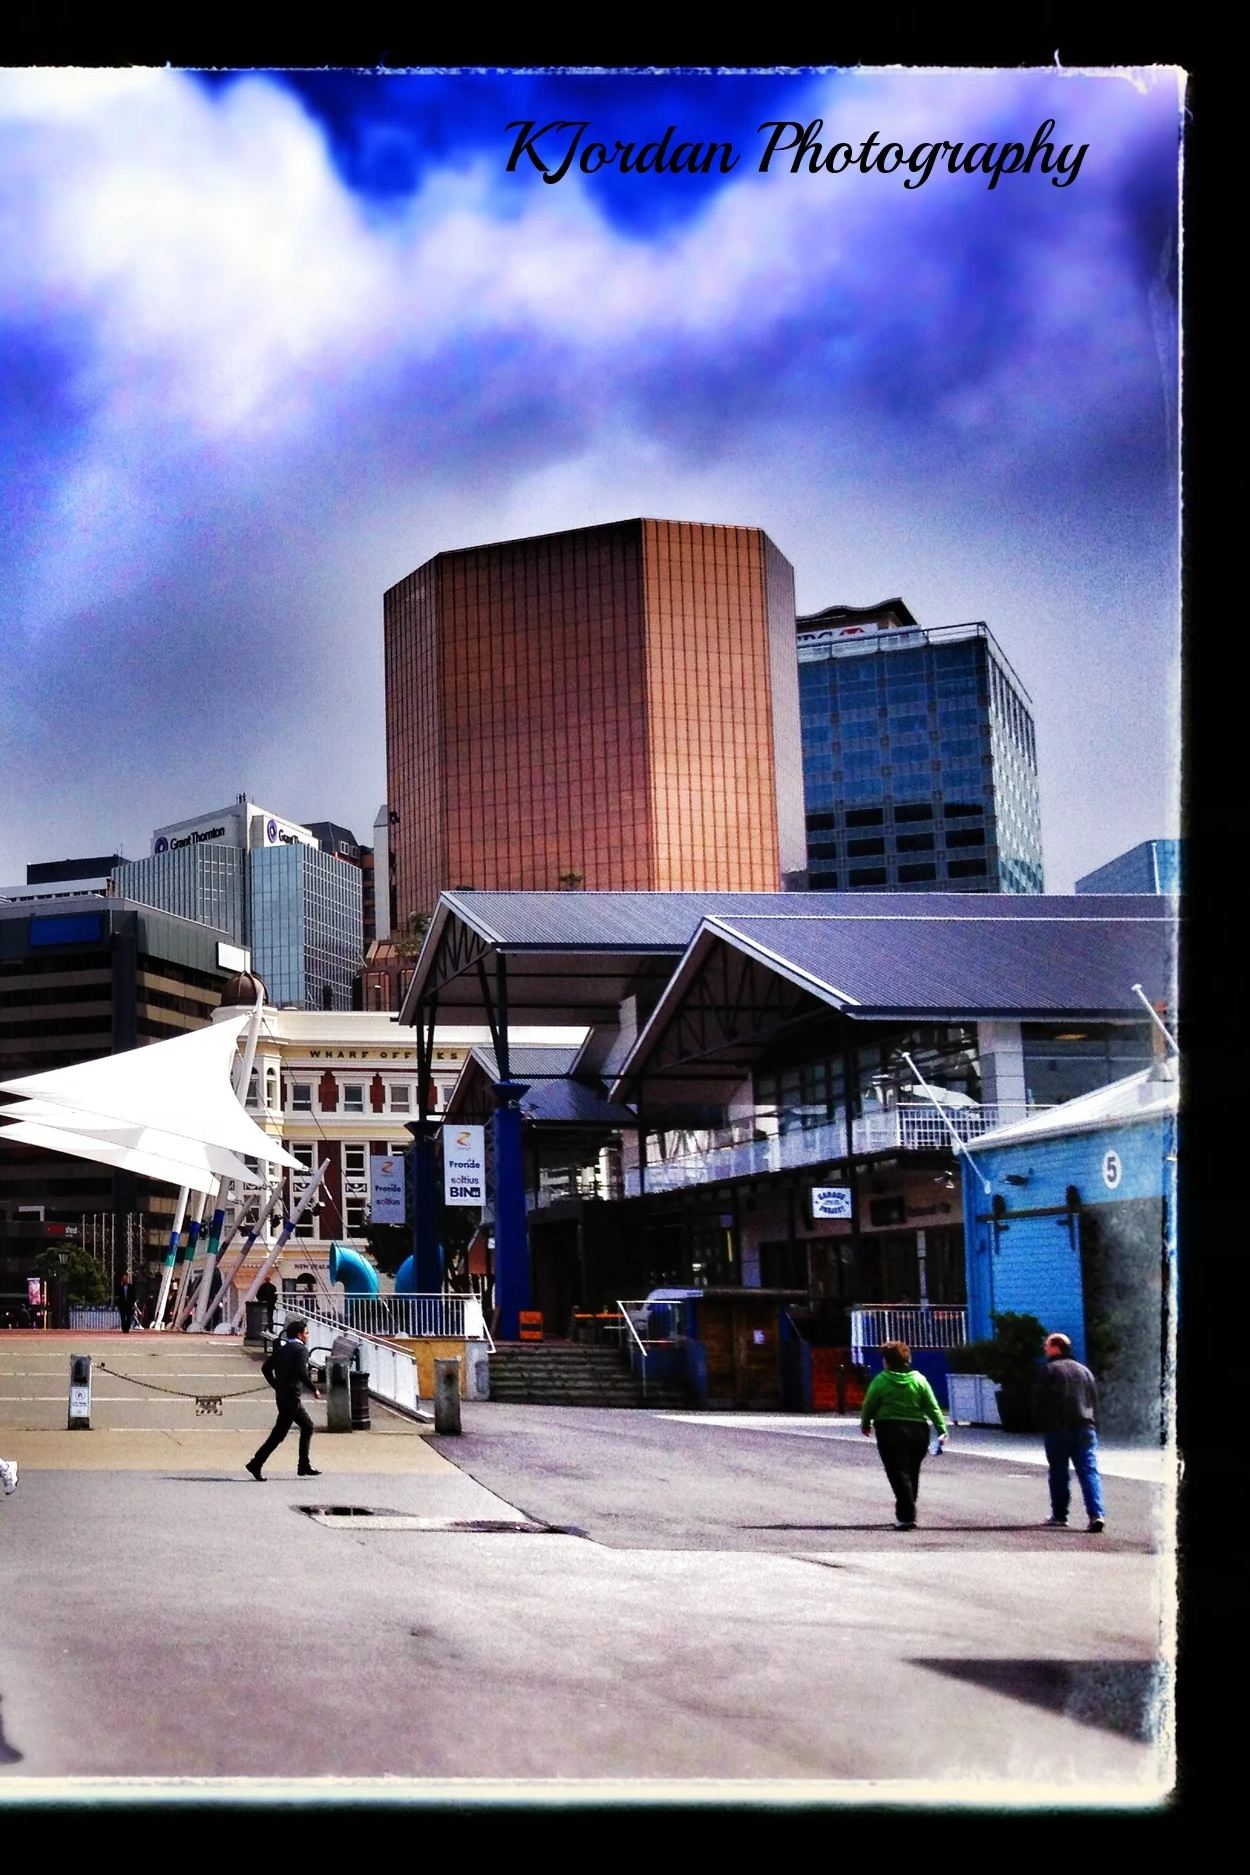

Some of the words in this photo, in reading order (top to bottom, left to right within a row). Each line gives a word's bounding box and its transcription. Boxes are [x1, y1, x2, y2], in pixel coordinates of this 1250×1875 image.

[170, 835, 191, 850] Grant
[191, 826, 225, 845] Thornton
[380, 1051, 458, 1060] OFFES
[449, 1159, 480, 1169] Fronde
[1107, 1156, 1117, 1182] 5
